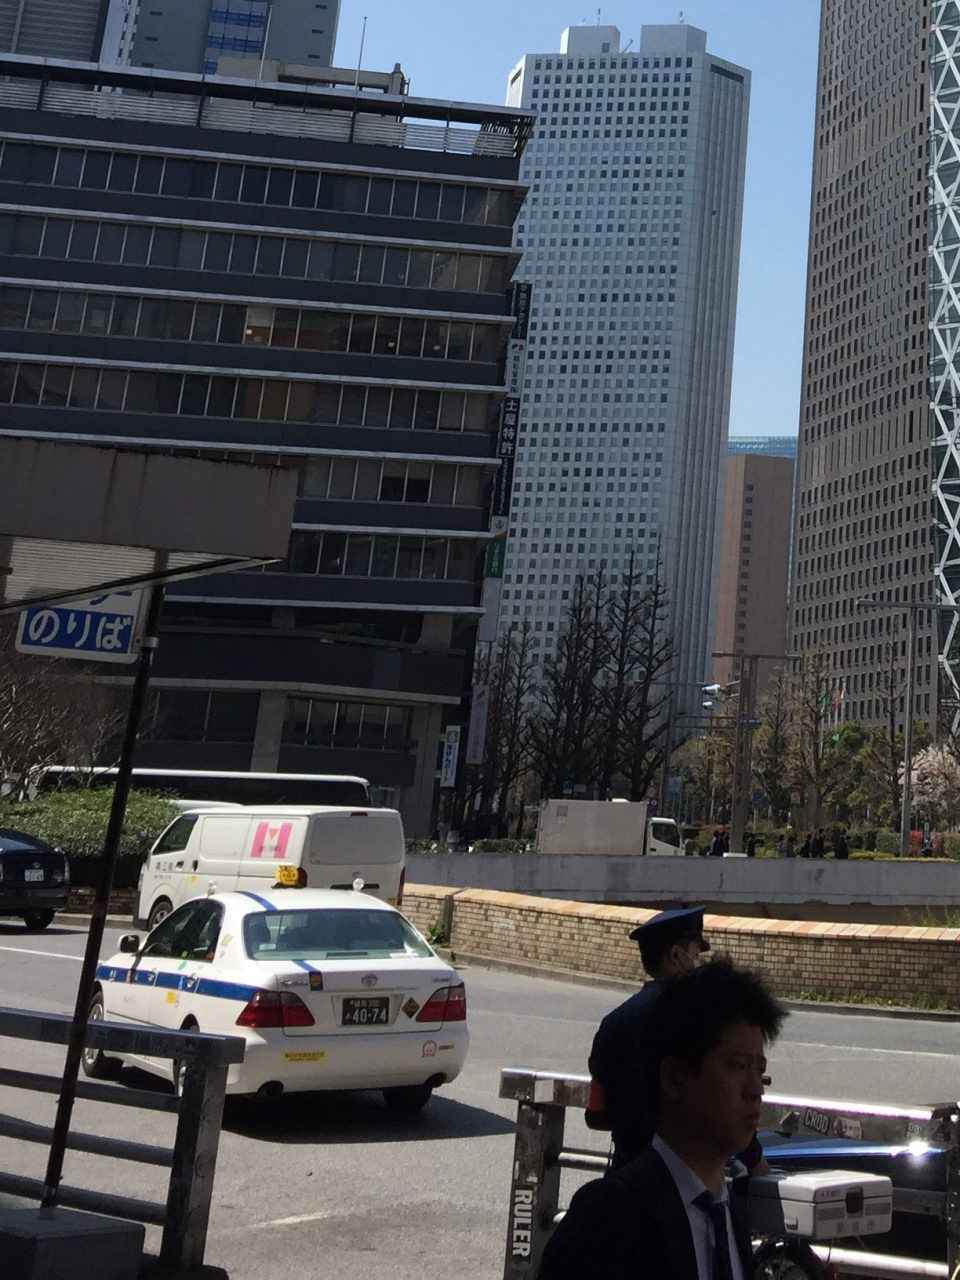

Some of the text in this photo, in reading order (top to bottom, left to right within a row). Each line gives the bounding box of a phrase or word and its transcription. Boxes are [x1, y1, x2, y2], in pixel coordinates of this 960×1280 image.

[28, 609, 132, 650] のりば
[512, 1189, 533, 1257] RULER
